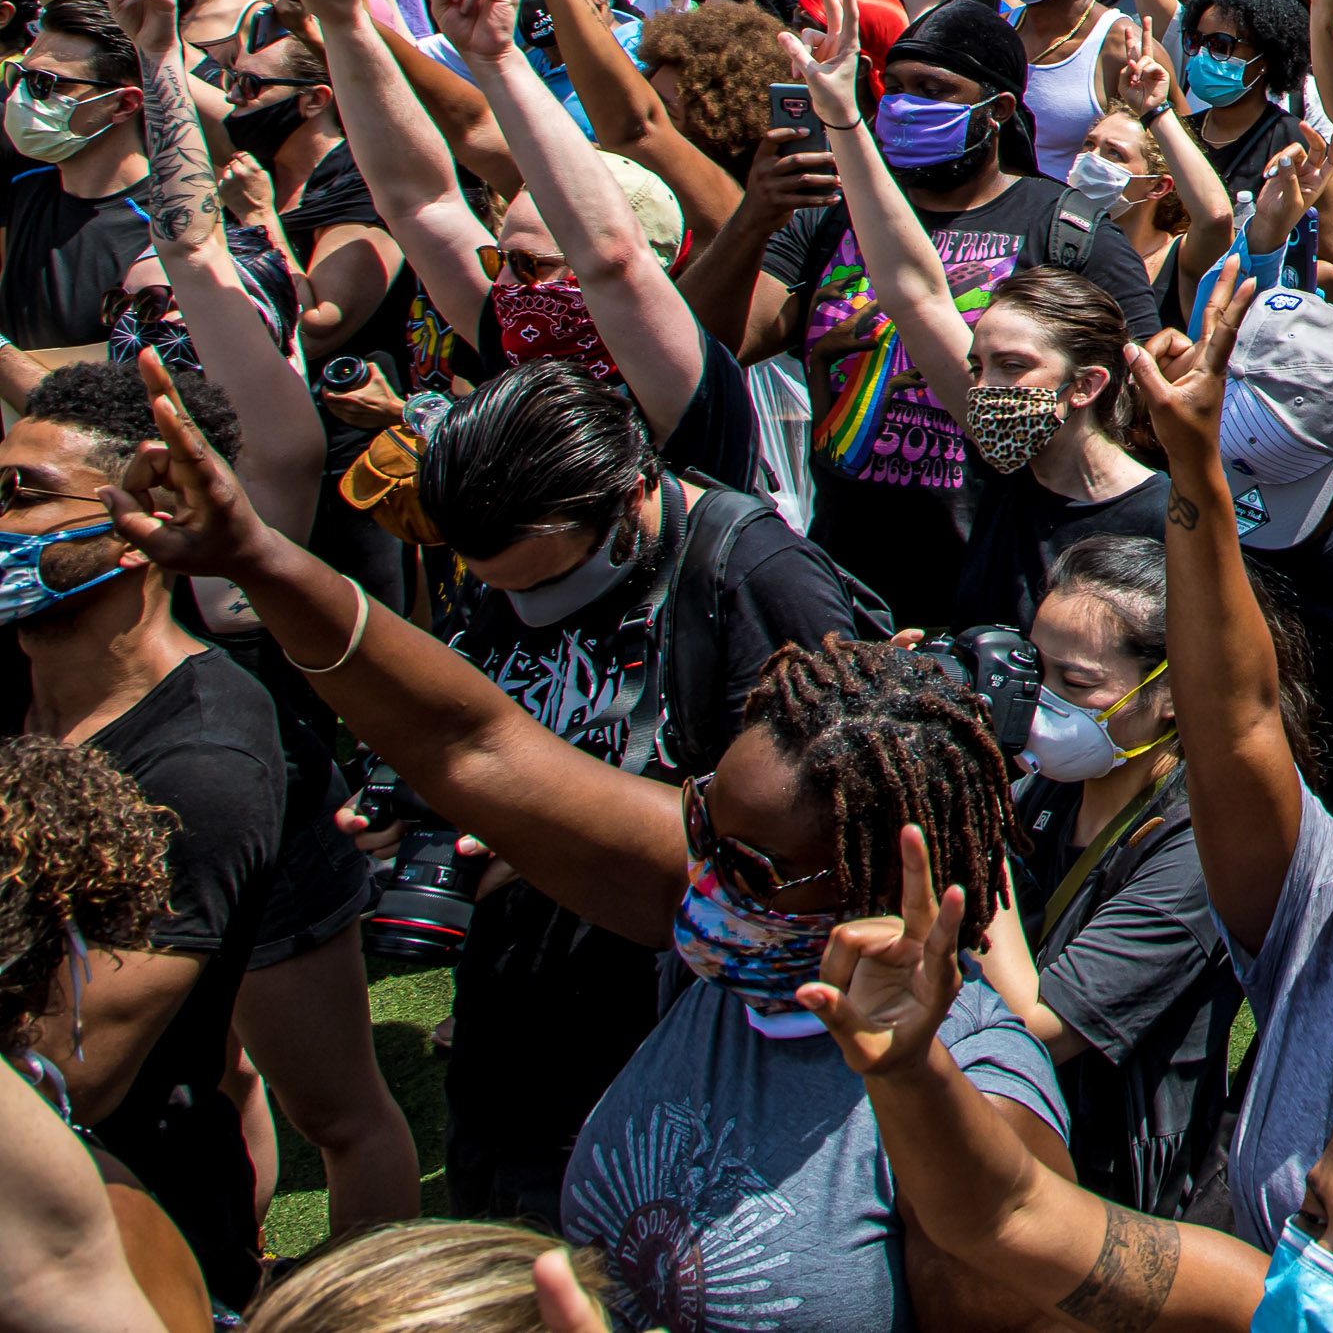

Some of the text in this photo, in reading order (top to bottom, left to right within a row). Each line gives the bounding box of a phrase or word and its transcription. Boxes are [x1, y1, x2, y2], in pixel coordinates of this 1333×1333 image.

[873, 423, 966, 462] 50TH
[858, 455, 965, 489] 1969-2019
[990, 674, 1005, 683] EOS
[991, 680, 1001, 688] 5D
